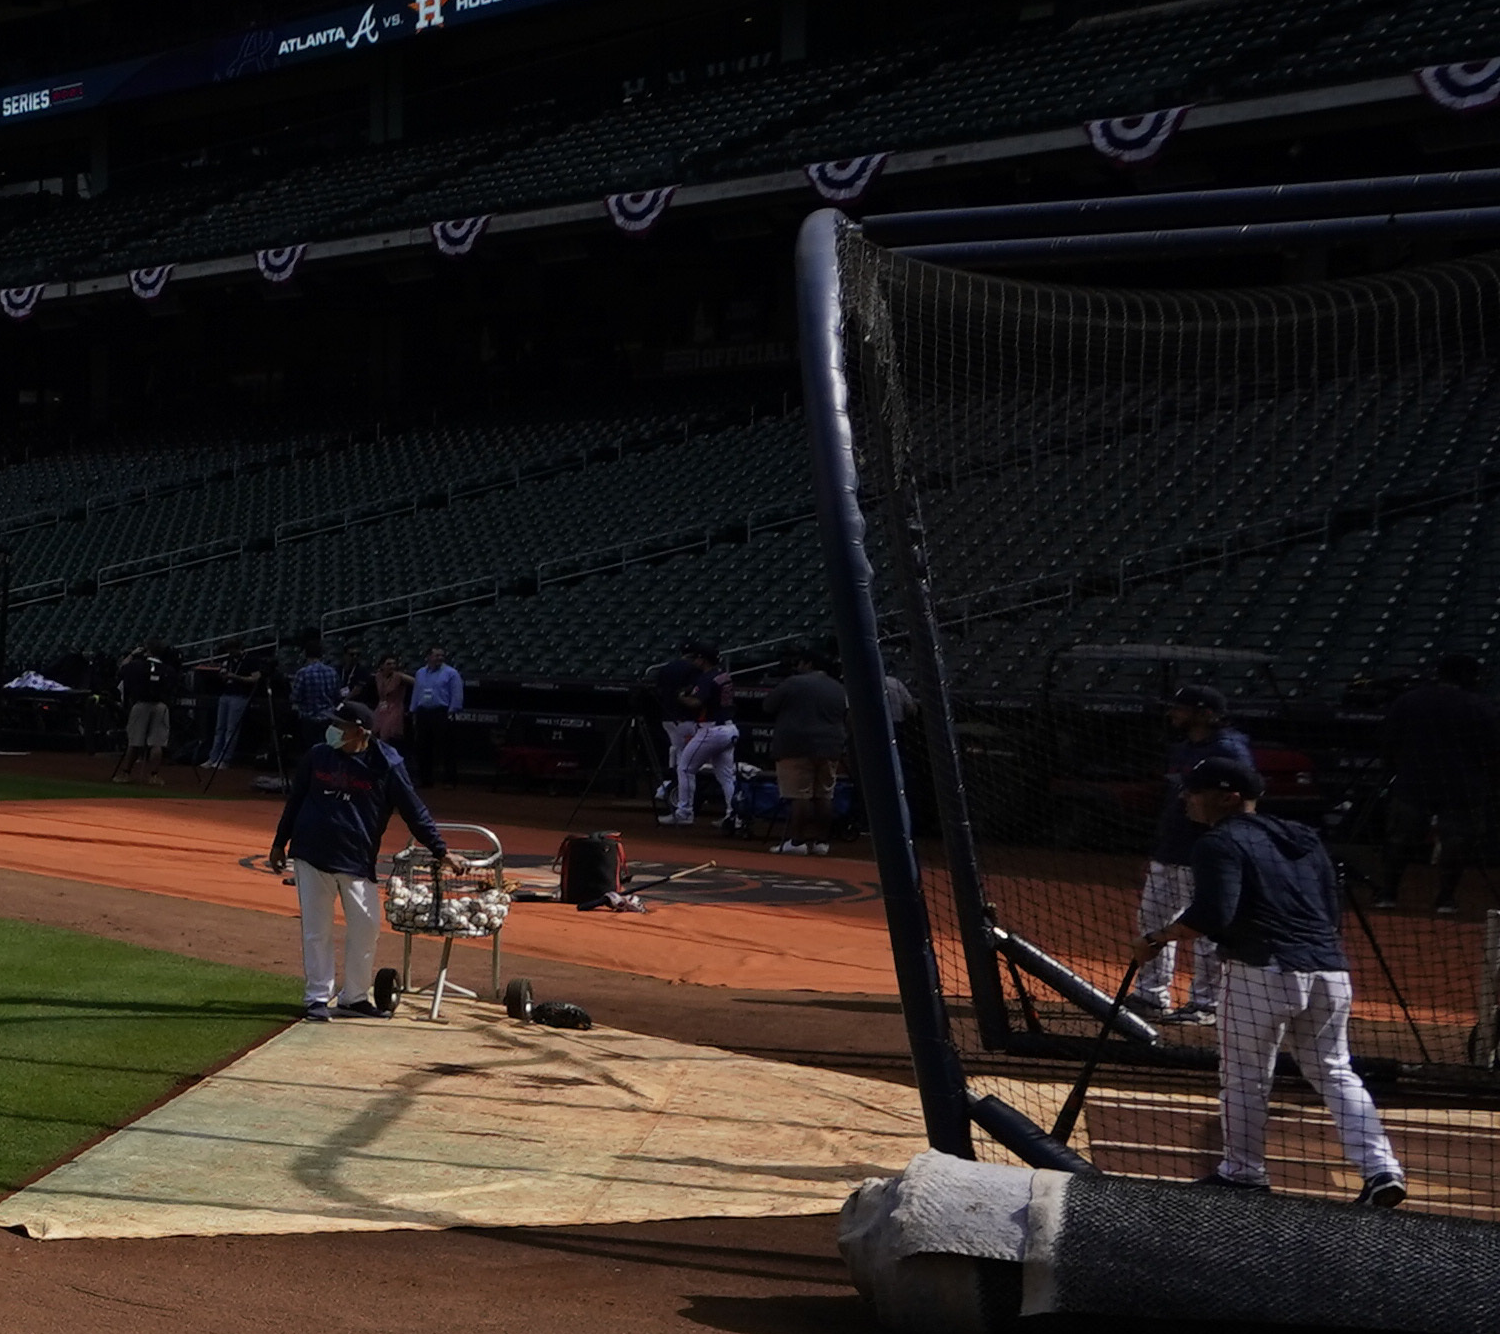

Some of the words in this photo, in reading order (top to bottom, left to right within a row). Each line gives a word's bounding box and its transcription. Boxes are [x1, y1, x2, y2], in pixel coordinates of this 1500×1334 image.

[277, 26, 346, 55] ATLANTA
[382, 12, 405, 28] VS.
[2, 88, 52, 117] SERIES
